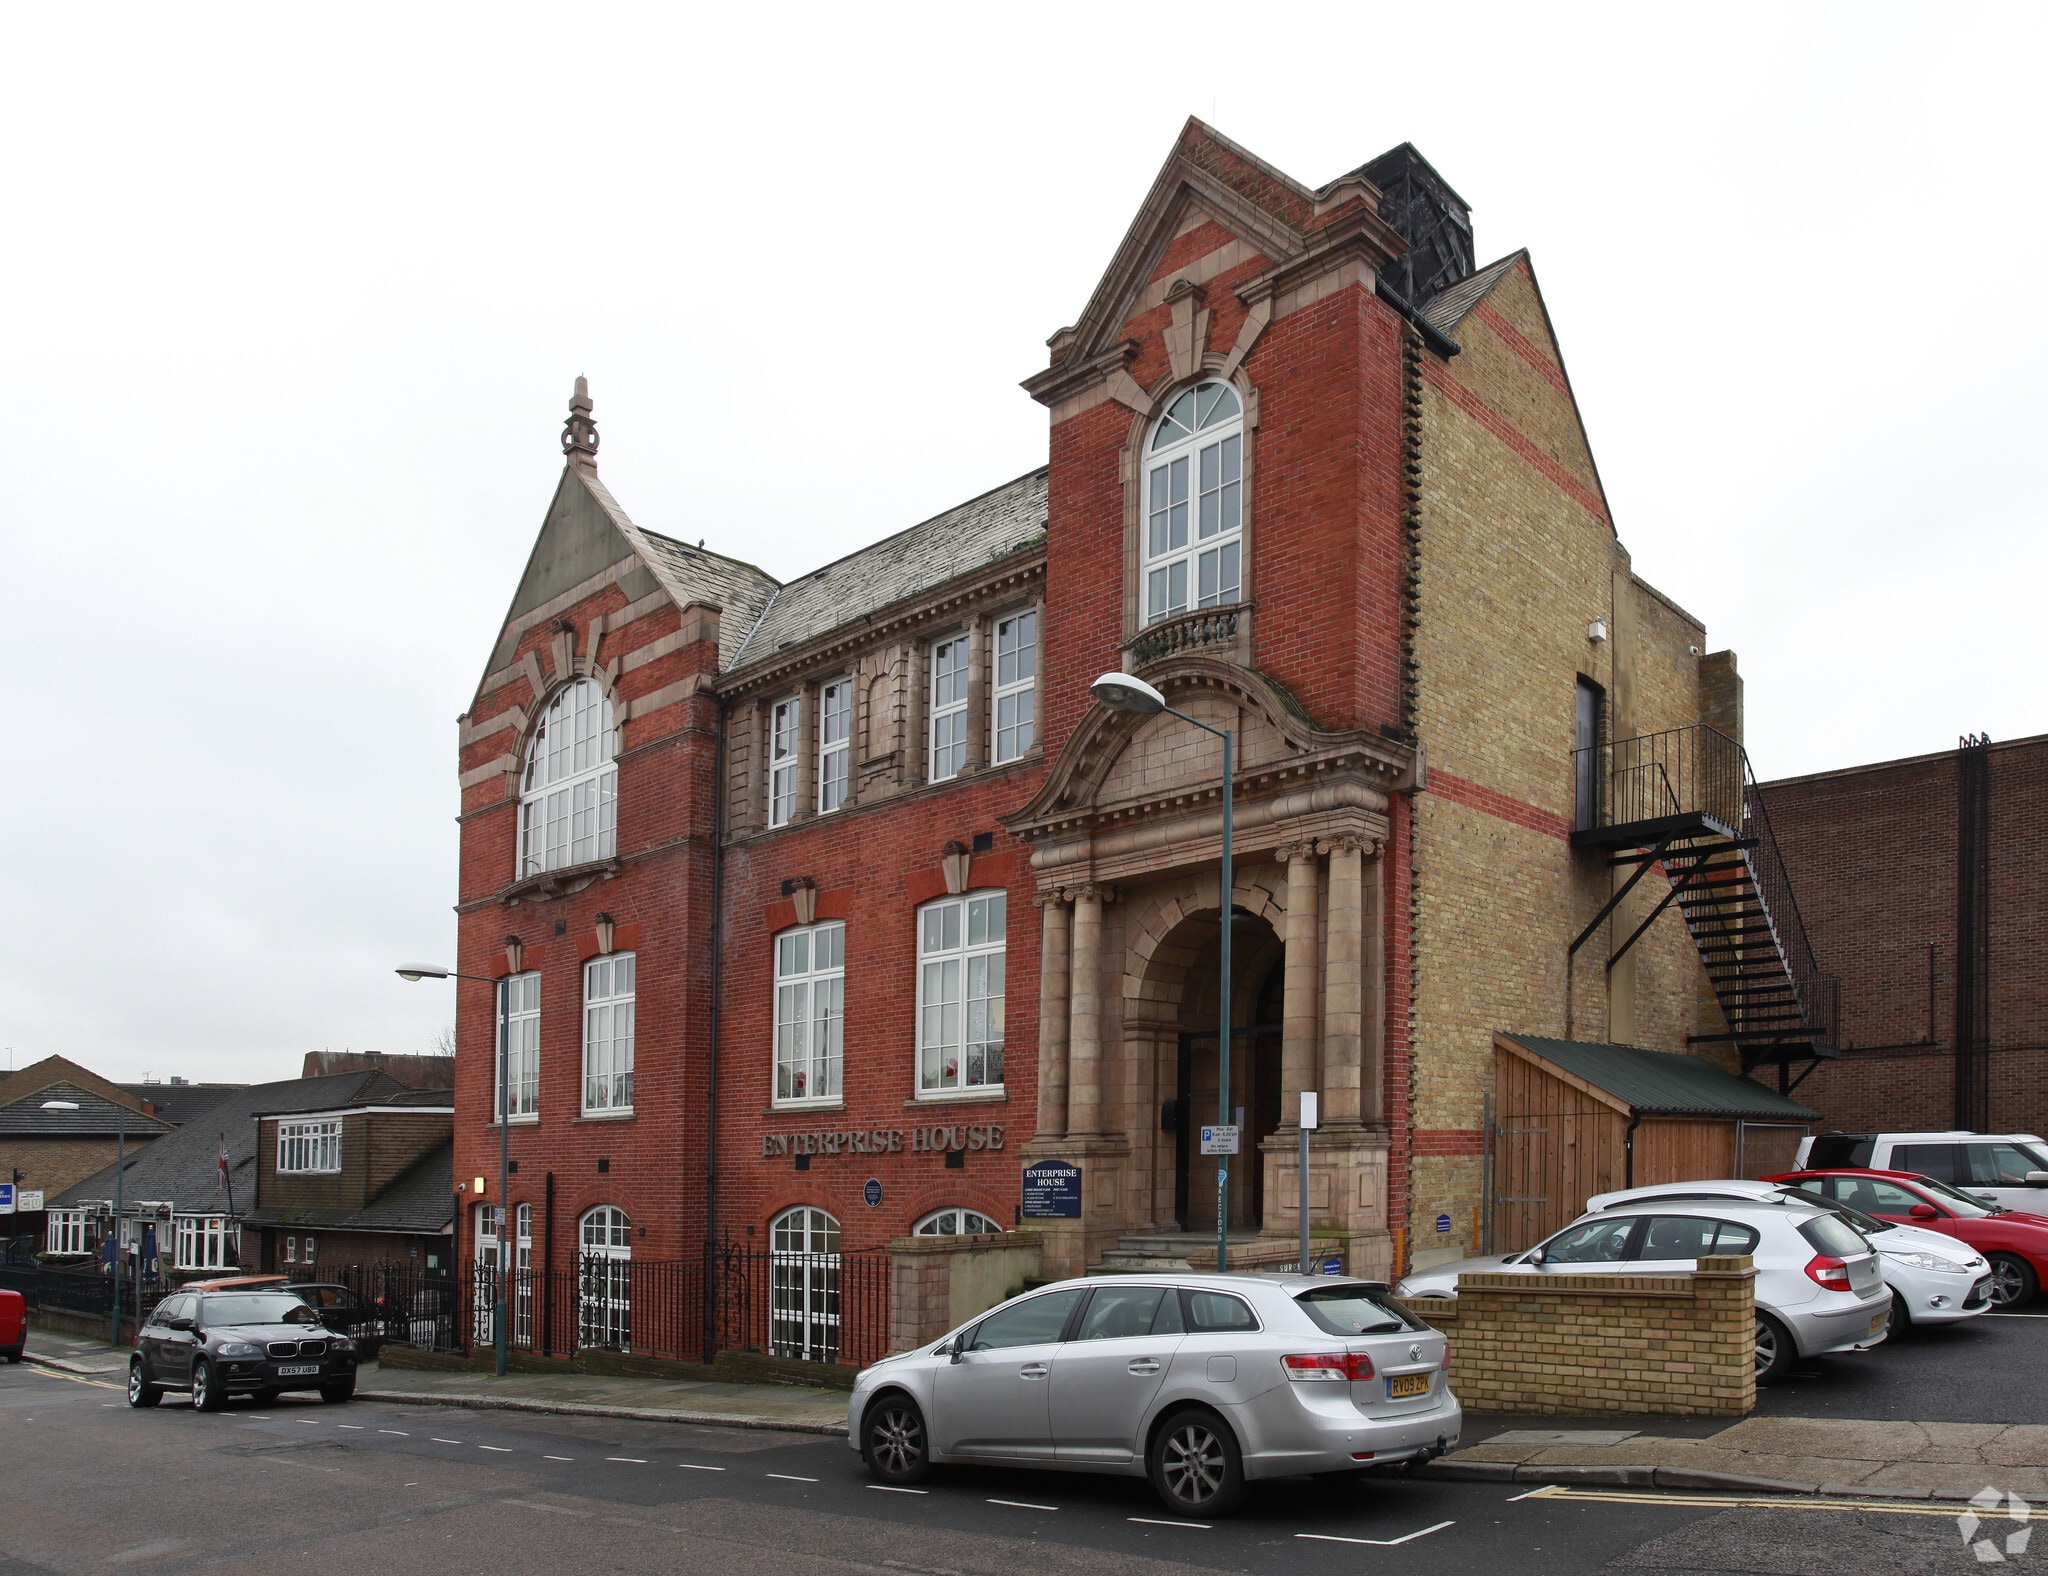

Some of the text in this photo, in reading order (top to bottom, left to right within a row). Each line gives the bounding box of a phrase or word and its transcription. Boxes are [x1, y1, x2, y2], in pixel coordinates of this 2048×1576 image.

[762, 1125, 1006, 1156] ENTERPRISE HOUSE
[1026, 1169, 1077, 1178] ENTERPRISE
[1393, 1375, 1430, 1394] RV09 ZPK
